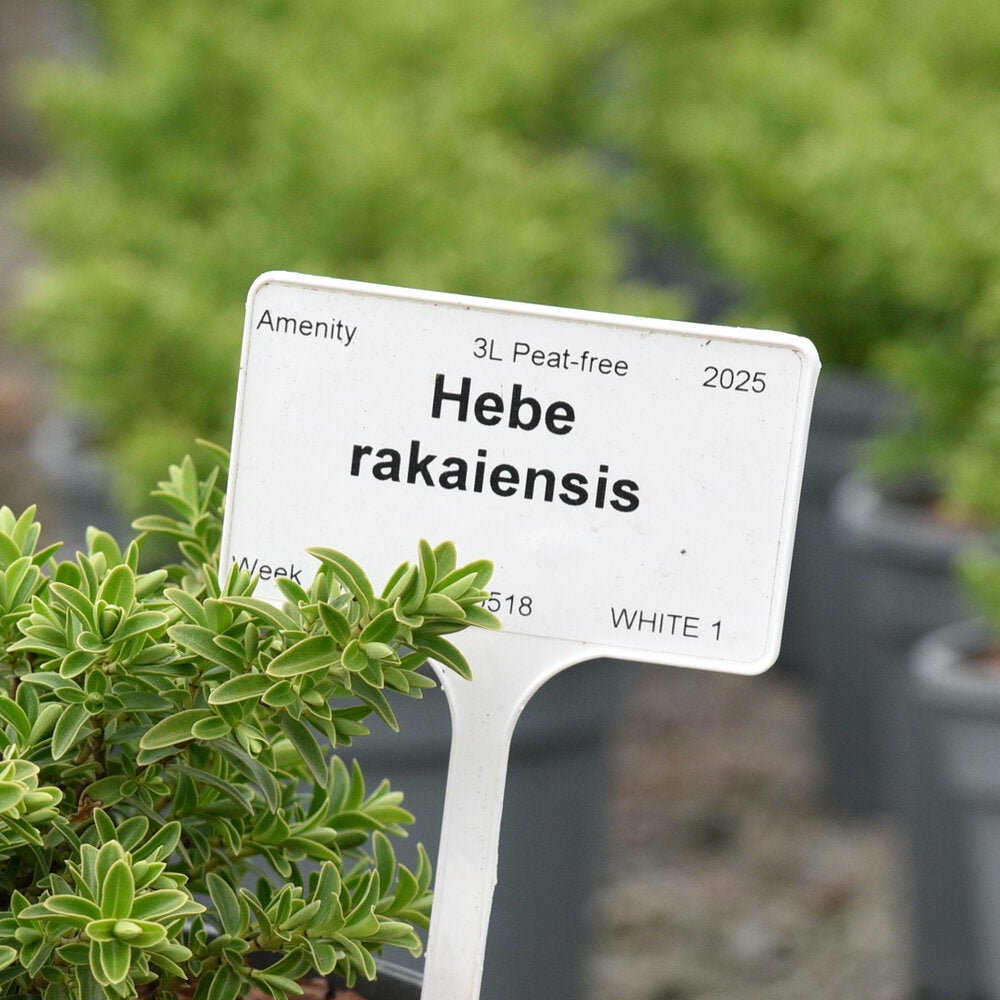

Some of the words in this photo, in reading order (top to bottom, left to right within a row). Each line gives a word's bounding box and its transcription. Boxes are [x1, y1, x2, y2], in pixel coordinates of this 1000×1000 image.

[256, 309, 357, 347] Amenity
[473, 337, 503, 362] 3L
[512, 342, 629, 377] Peat-free
[702, 366, 767, 394] 2025
[431, 372, 577, 436] Hebe
[350, 439, 640, 513] rakaiensis
[481, 591, 533, 617] 518
[610, 607, 700, 639] WHITE
[711, 620, 722, 641] 1
